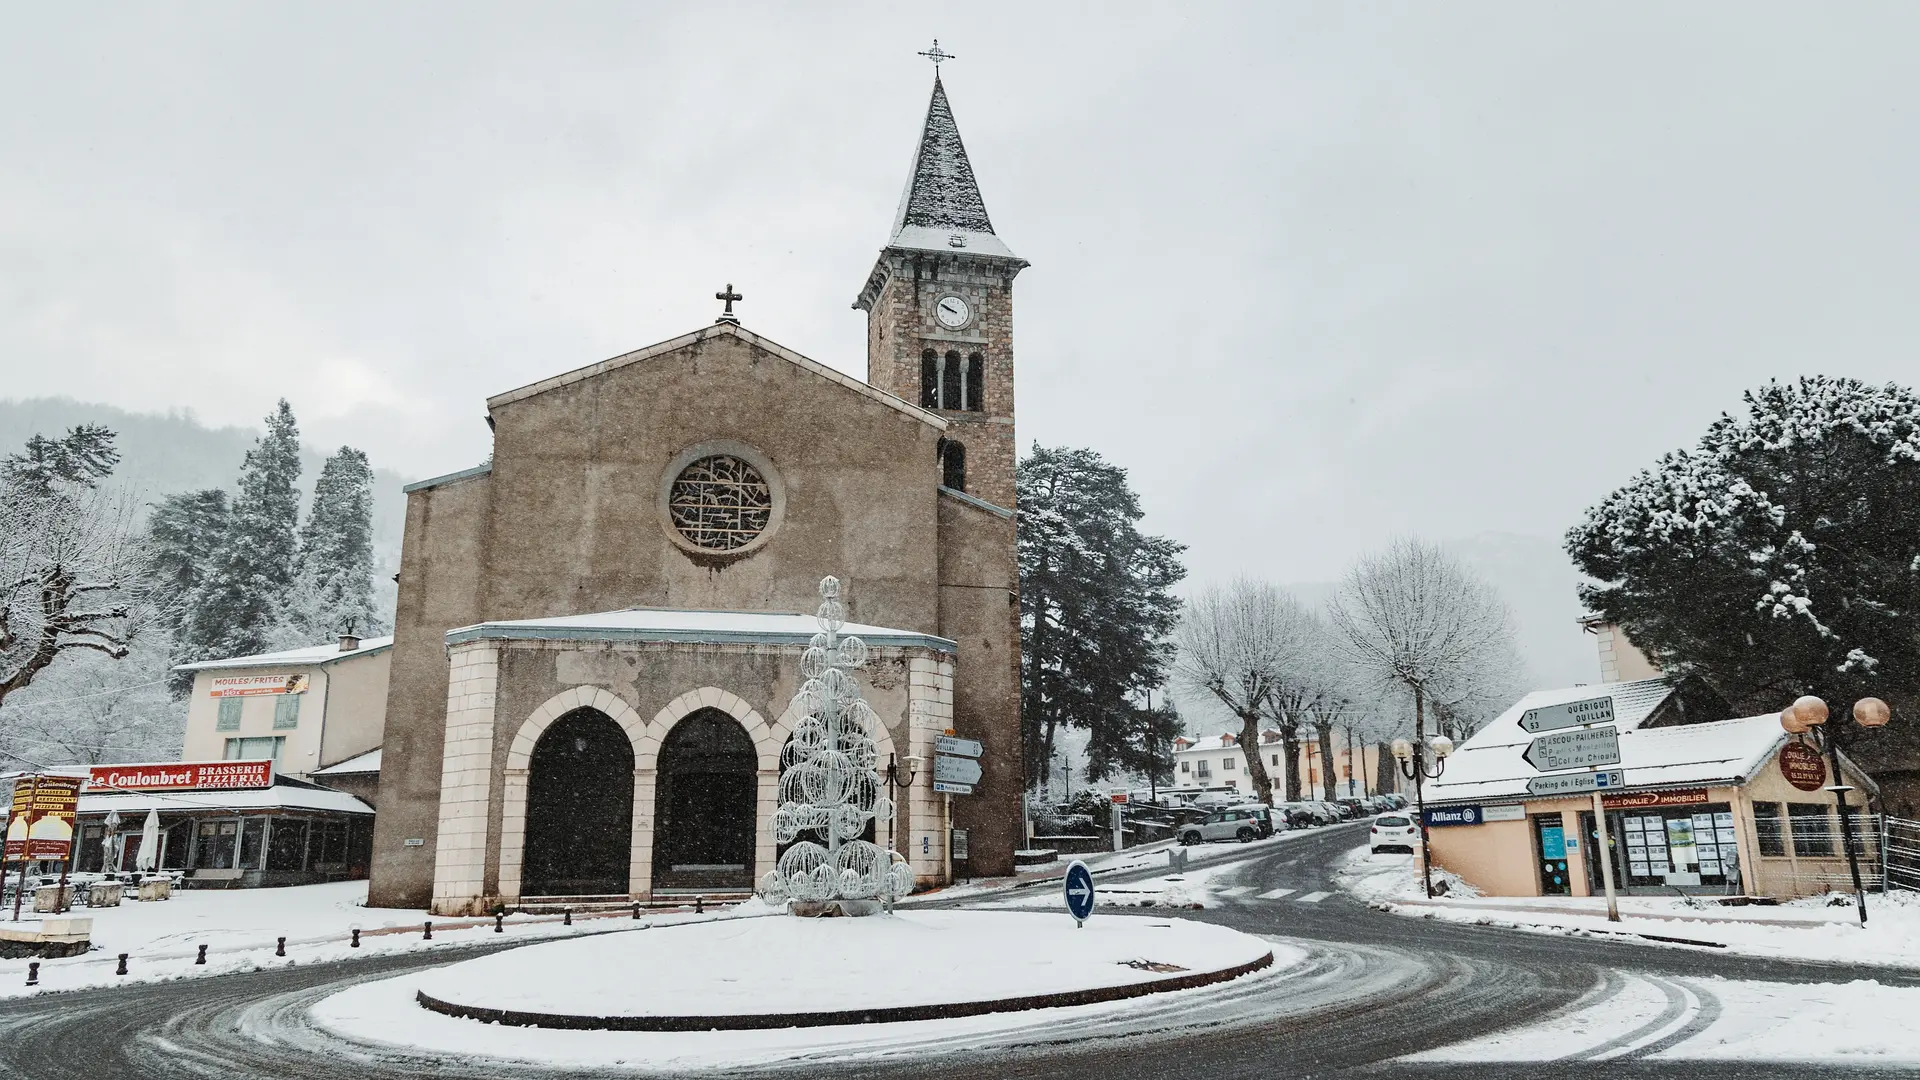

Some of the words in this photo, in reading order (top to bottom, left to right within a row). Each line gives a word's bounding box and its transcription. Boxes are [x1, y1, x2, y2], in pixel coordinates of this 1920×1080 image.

[215, 676, 284, 686] MOULES/FRITES
[1529, 712, 1538, 720] 37
[1576, 710, 1611, 722] QUILLAN
[1588, 752, 1616, 761] Chioula
[199, 765, 264, 775] BRASSERIE
[88, 774, 104, 787] Le
[109, 770, 192, 786] Couloubret
[198, 775, 263, 783] PIZZERIA
[195, 781, 267, 789] RESTAURANT
[1534, 780, 1558, 790] Parking
[1561, 779, 1568, 787] de
[1661, 794, 1706, 803] IMMOBILIER
[1431, 812, 1462, 822] Allianz
